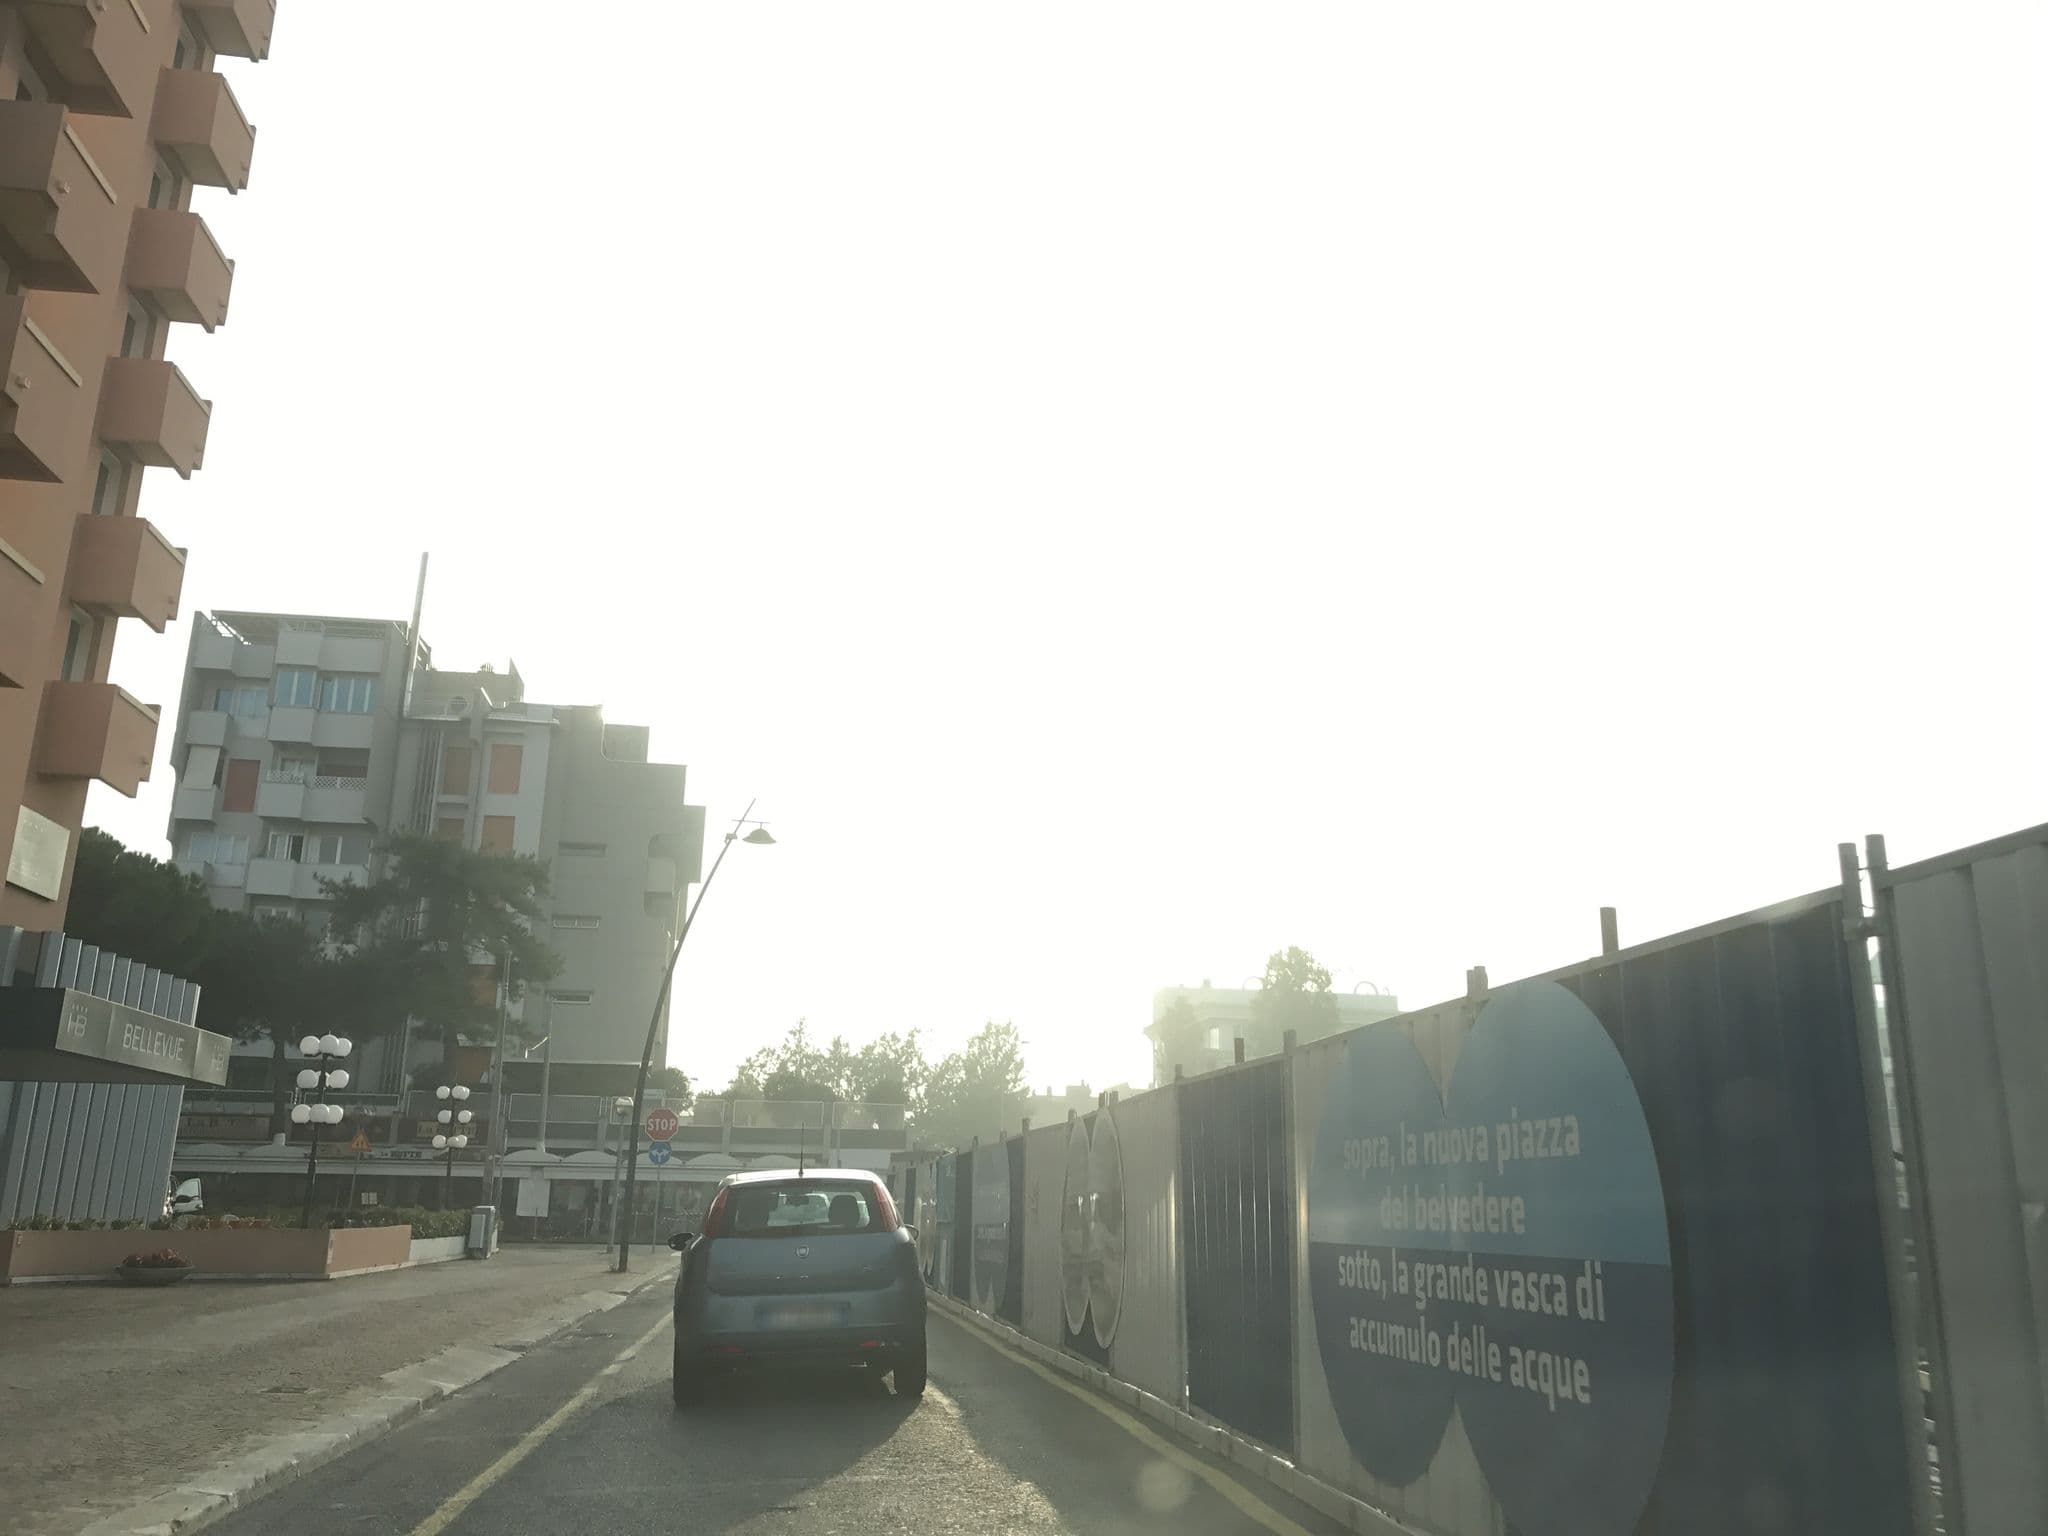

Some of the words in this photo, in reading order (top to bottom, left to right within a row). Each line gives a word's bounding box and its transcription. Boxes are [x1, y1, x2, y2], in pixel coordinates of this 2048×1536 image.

[122, 1022, 185, 1063] BELLEVUE
[647, 1118, 677, 1131] STOP
[1343, 1134, 1396, 1178] sopra,
[1400, 1121, 1418, 1166] la
[1423, 1125, 1489, 1164] nuova
[1496, 1106, 1581, 1175] piazza
[1379, 1186, 1409, 1231] del
[1415, 1182, 1526, 1234] belvedere
[1337, 1248, 1388, 1300] sotto,
[1392, 1248, 1409, 1296] la
[1414, 1253, 1489, 1311] grande
[1493, 1268, 1569, 1317] vasca
[1576, 1260, 1606, 1322] di
[1350, 1314, 1441, 1369] accumulo
[1447, 1320, 1503, 1383] delle
[1509, 1345, 1592, 1413] acque
